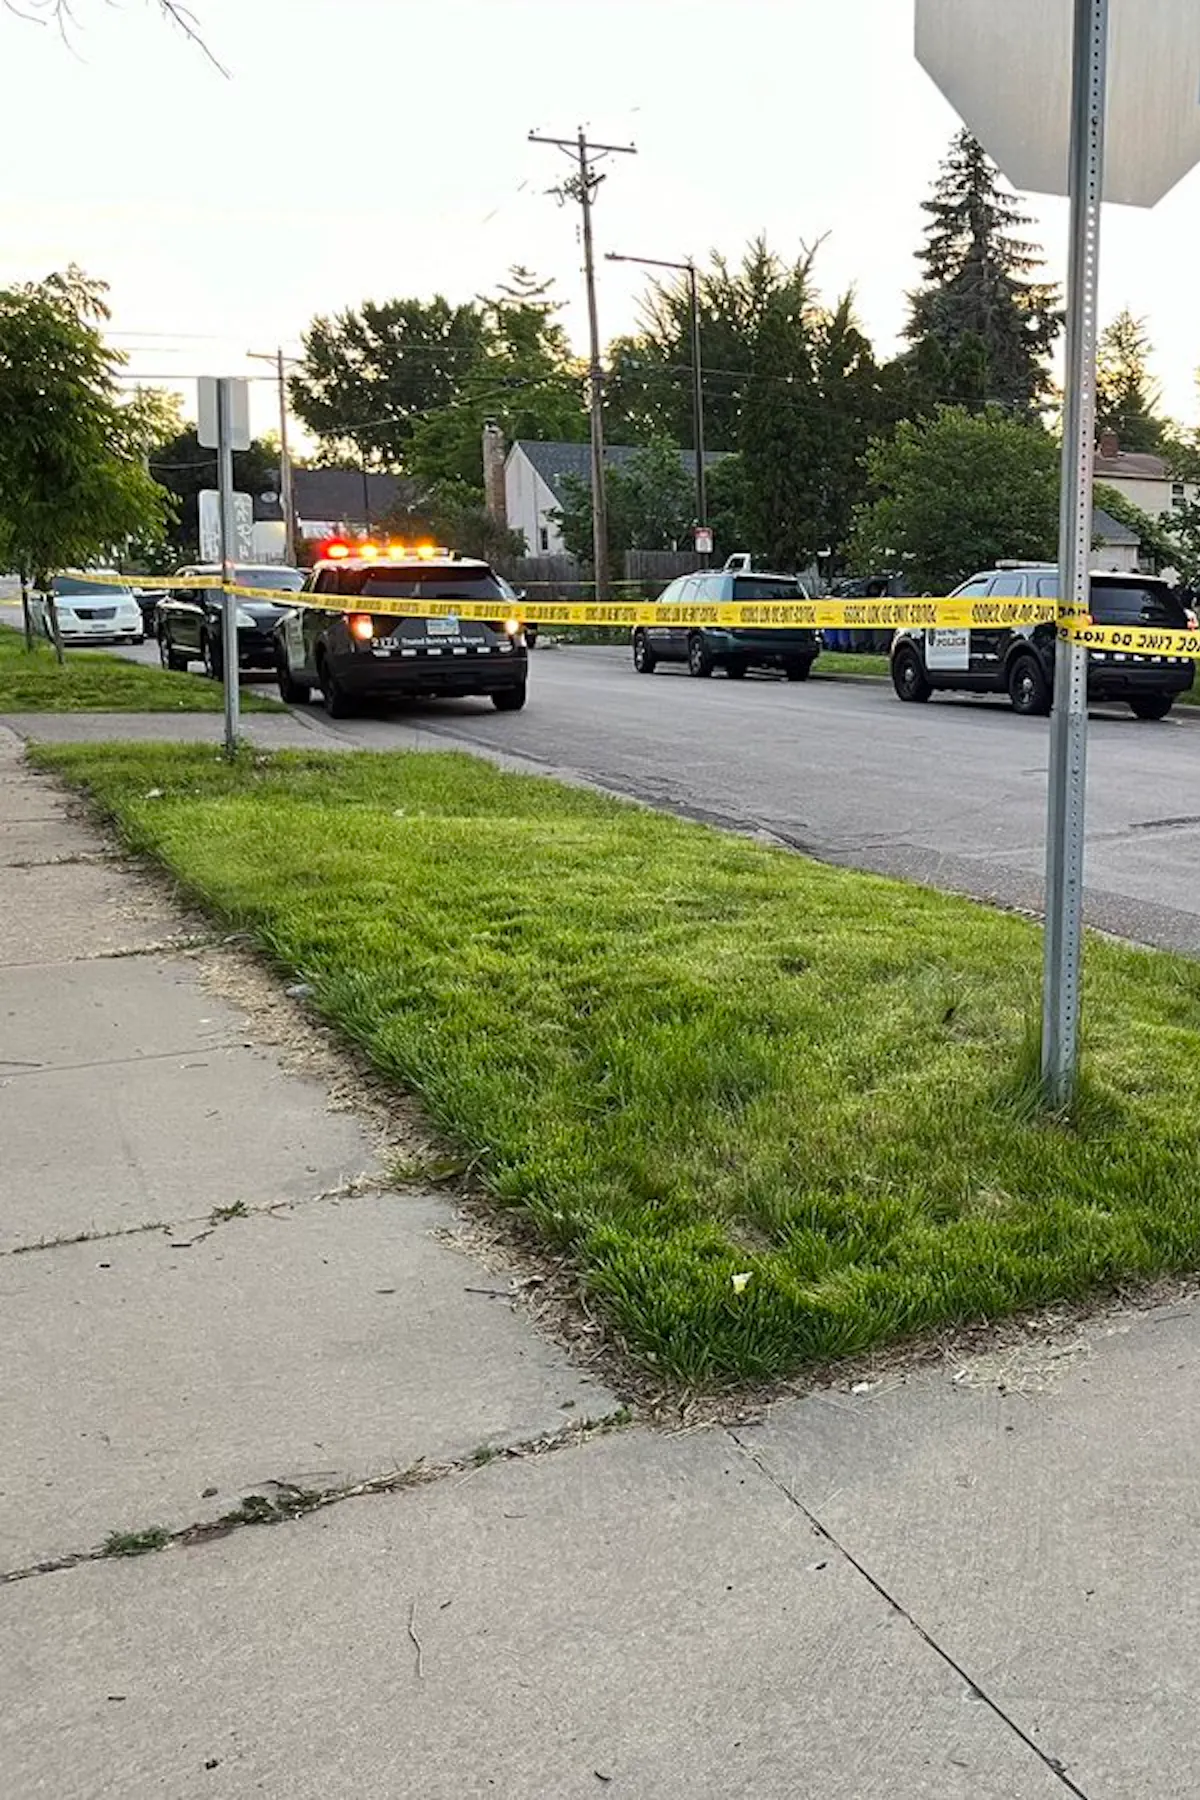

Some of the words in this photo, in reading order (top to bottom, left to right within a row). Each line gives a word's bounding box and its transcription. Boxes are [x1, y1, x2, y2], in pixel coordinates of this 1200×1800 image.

[1074, 630, 1104, 645] NOT
[1112, 632, 1132, 646] DO
[1136, 634, 1172, 651] LINE
